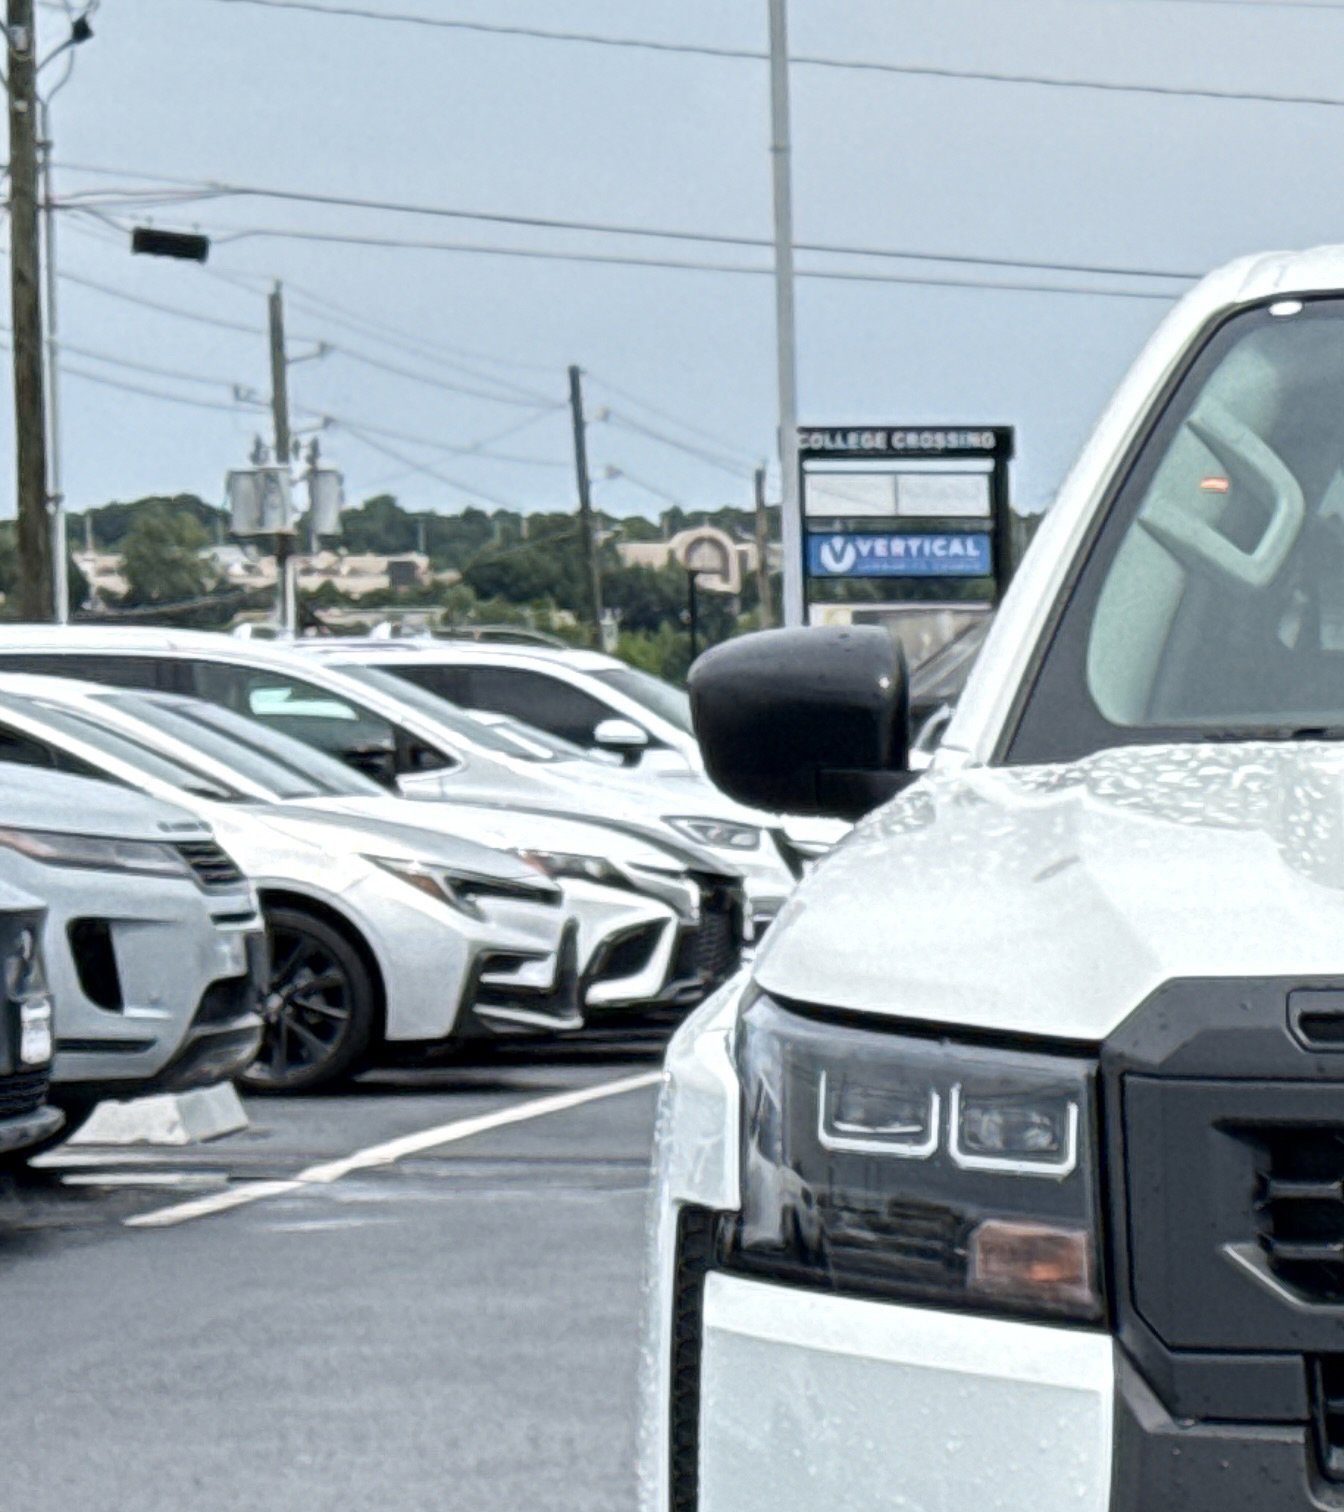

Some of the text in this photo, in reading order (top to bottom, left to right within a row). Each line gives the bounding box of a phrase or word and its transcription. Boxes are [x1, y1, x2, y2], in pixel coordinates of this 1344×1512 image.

[799, 431, 996, 449] COLLEGE CROSSING
[856, 537, 979, 557] VERTICAL
